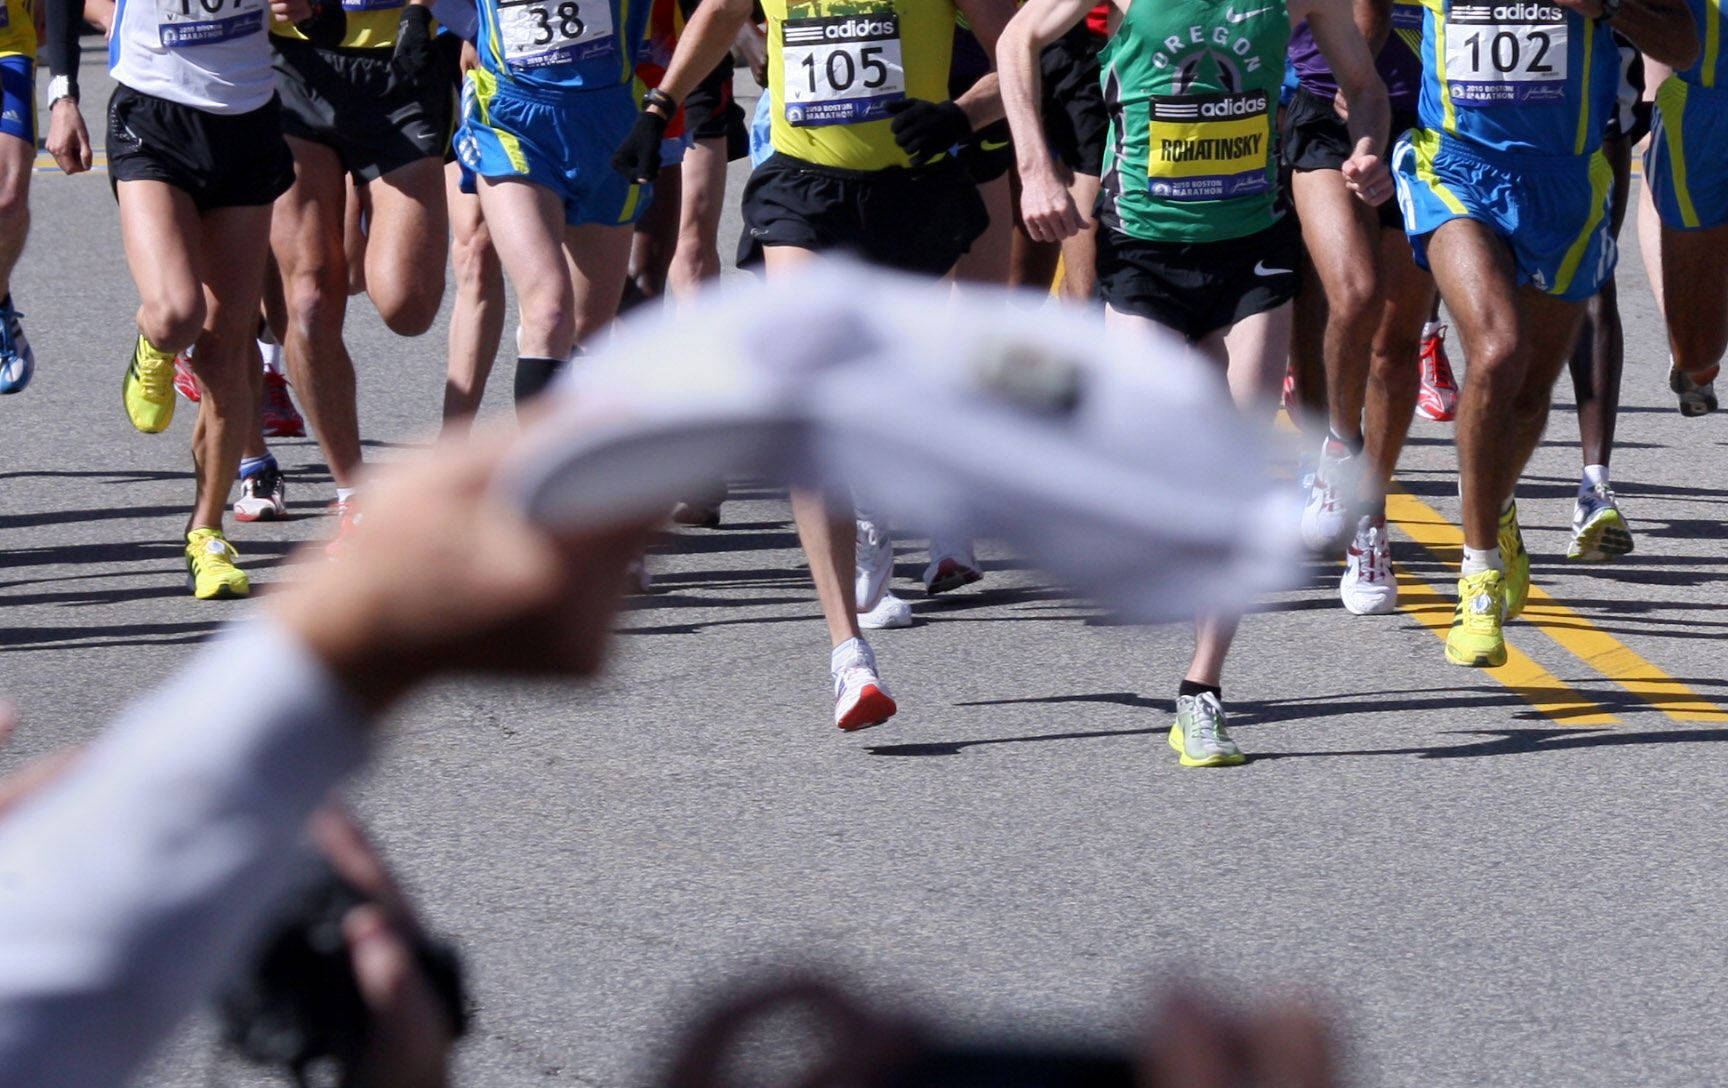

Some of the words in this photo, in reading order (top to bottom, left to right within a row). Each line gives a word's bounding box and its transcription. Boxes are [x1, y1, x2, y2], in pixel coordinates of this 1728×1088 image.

[1493, 3, 1563, 21] adidas
[529, 1, 584, 46] 38
[825, 19, 894, 39] adidas
[1152, 25, 1262, 73] OREGON
[1465, 31, 1553, 73] 102
[802, 46, 888, 93] 105
[806, 110, 853, 120] MARATHON
[823, 103, 853, 112] BOSTON
[1201, 96, 1267, 117] adidas
[1172, 186, 1223, 196] MARATHON
[1192, 180, 1223, 188] BOSTON
